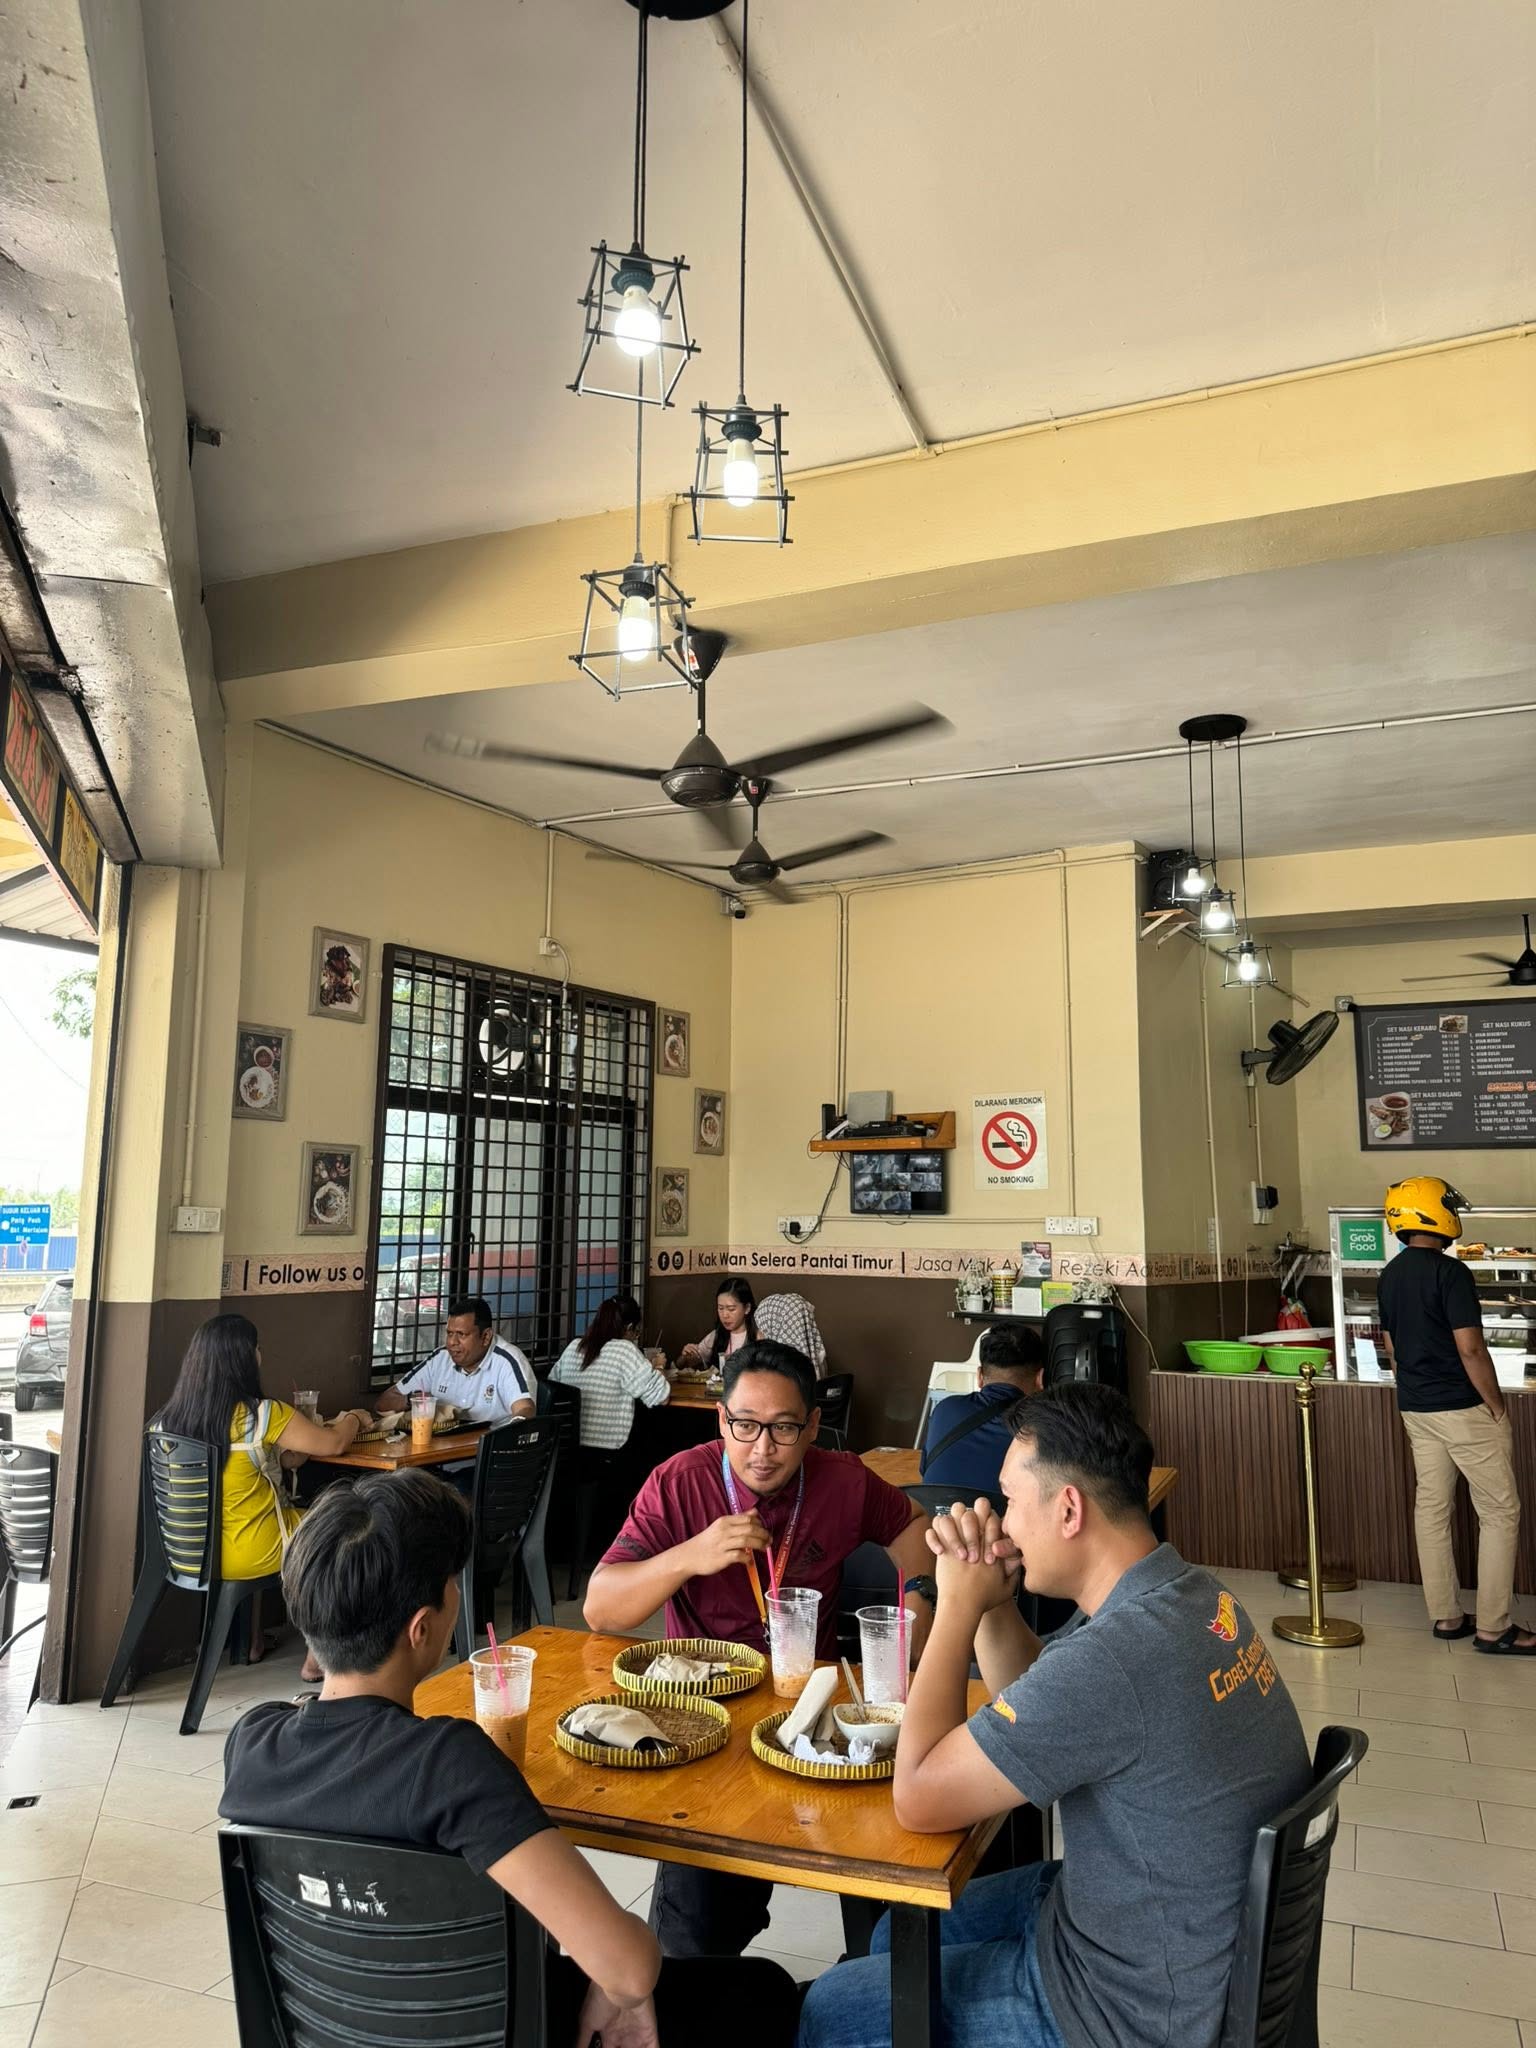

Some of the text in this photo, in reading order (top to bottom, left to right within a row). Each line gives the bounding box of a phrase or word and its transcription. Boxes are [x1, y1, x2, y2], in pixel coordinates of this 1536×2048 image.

[974, 1096, 1042, 1107] DILARANG MEROKOK
[1350, 1233, 1375, 1242] Grab
[1350, 1242, 1376, 1251] Food
[698, 1252, 893, 1270] Kak Wan Selera Pantai Timur
[914, 1256, 952, 1272] Jasa
[1002, 1258, 1023, 1277] Ay
[1060, 1259, 1119, 1277] Rezeki
[258, 1265, 364, 1285] Follow us o
